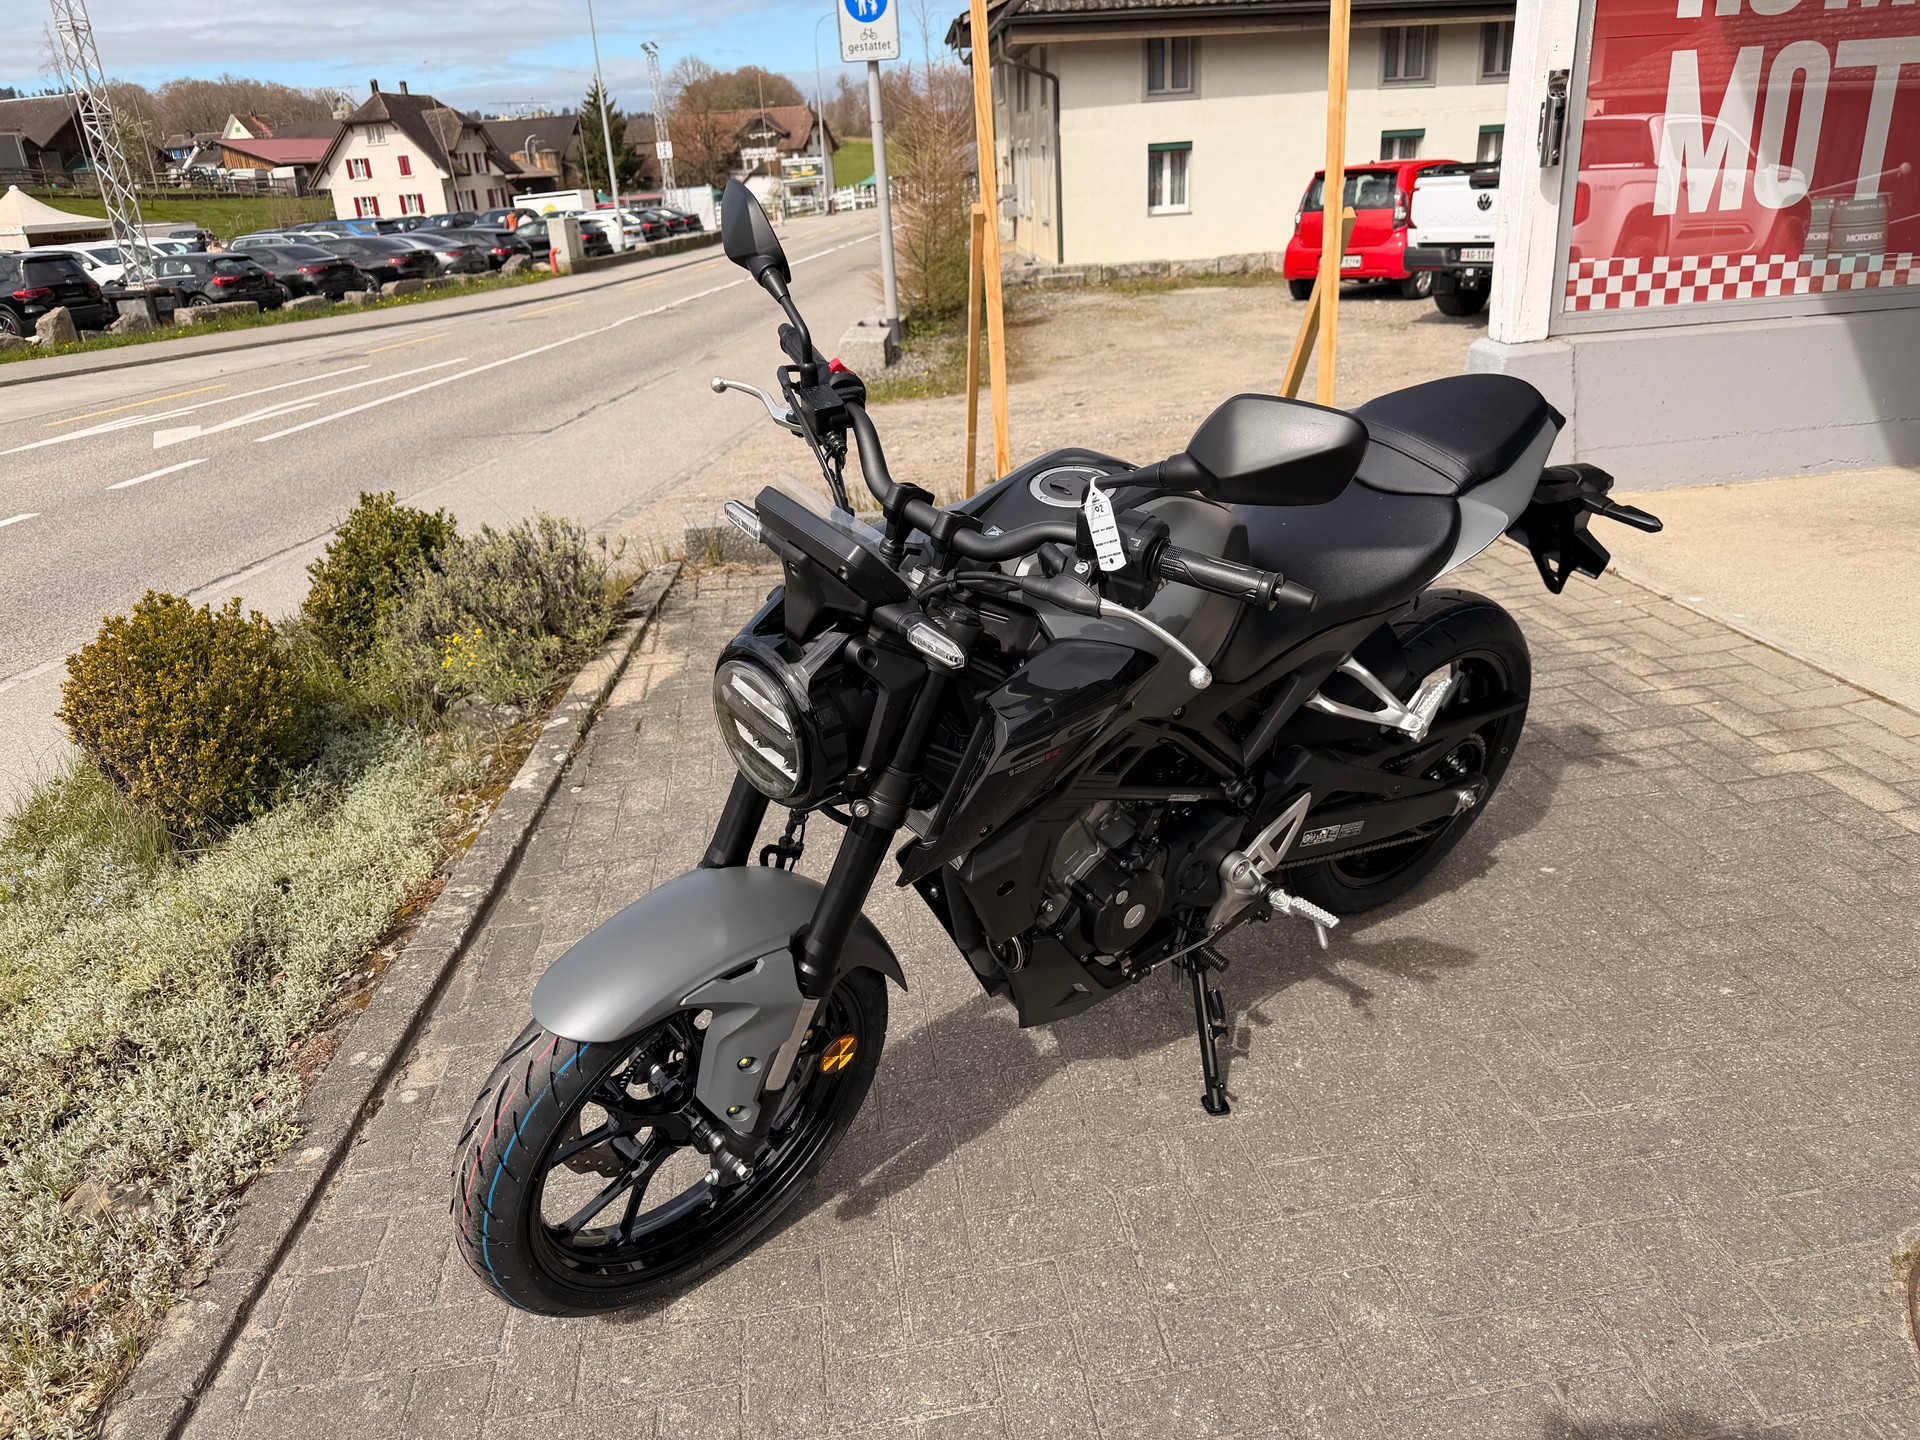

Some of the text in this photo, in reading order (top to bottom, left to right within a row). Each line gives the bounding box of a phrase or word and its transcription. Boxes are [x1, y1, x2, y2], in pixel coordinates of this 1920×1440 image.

[848, 41, 891, 54] gestattet
[53, 233, 82, 241] Garage
[1846, 231, 1884, 242] MOTOREX
